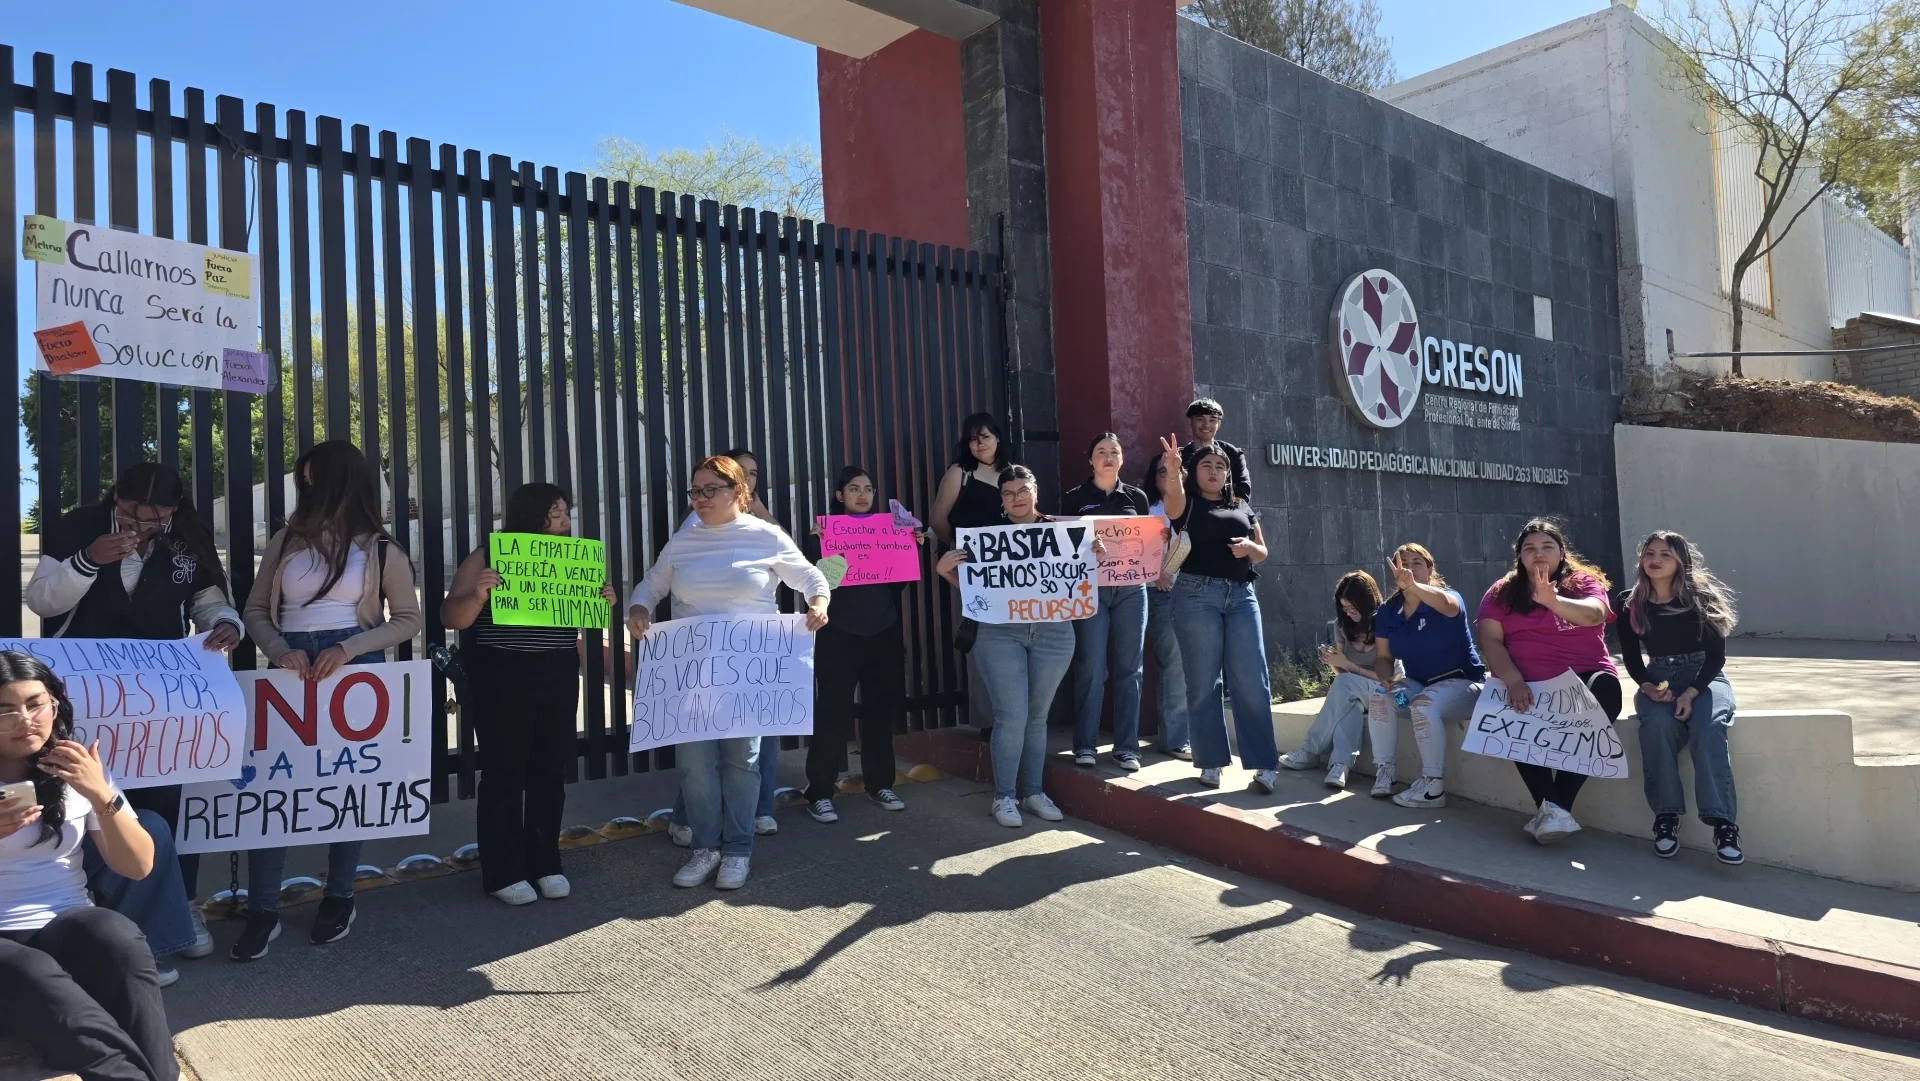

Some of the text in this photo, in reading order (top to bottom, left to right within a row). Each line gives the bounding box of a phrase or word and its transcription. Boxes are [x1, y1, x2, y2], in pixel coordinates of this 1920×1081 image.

[26, 234, 63, 253] Melina
[66, 229, 197, 286] Callarnos
[205, 258, 233, 273] Fuera
[205, 270, 228, 283] Paz
[52, 277, 238, 330] nunca Será la
[39, 338, 73, 351] Fuera
[92, 323, 219, 373] Solución
[223, 359, 252, 371] Fuera
[1423, 335, 1524, 398] CRESON
[1424, 393, 1448, 408] Centro
[1449, 396, 1477, 413] Regional
[1479, 400, 1487, 413] de
[1424, 408, 1464, 426] Profesional
[1271, 443, 1569, 486] UNIVERSIDAD PEDAGÓGICA NACIONAL UNIDAD 263 NOGALES
[832, 521, 876, 536] Escuchar
[881, 528, 889, 536] a
[891, 524, 909, 537] los
[498, 538, 605, 563] LA EMPATÍA NO
[825, 539, 872, 551] Estudiantes
[857, 552, 870, 561] es
[496, 560, 605, 583] DEBERÍA VENIR
[845, 565, 880, 582] Educar
[967, 561, 1095, 590] MENOS DISCUR-
[520, 581, 536, 593] UN
[541, 581, 603, 600] REGLAMENT
[1065, 580, 1077, 599] Y
[495, 596, 519, 610] PARA
[528, 597, 548, 611] SER
[1008, 596, 1096, 621] RECURSOS
[642, 619, 794, 662] NO CASTIGUEN
[60, 642, 201, 671] LLAMARON
[636, 655, 791, 699] LAS VOCES QUE
[61, 673, 219, 719] ELDES POR
[631, 687, 807, 745] BUSCAN CAMBIOS
[96, 711, 231, 780] DERECHOS
[1477, 714, 1625, 760] EXIGIMOS
[269, 743, 382, 780] A LAS
[1481, 735, 1619, 778] DERECHOS
[183, 778, 431, 841] REPRESALIAS
